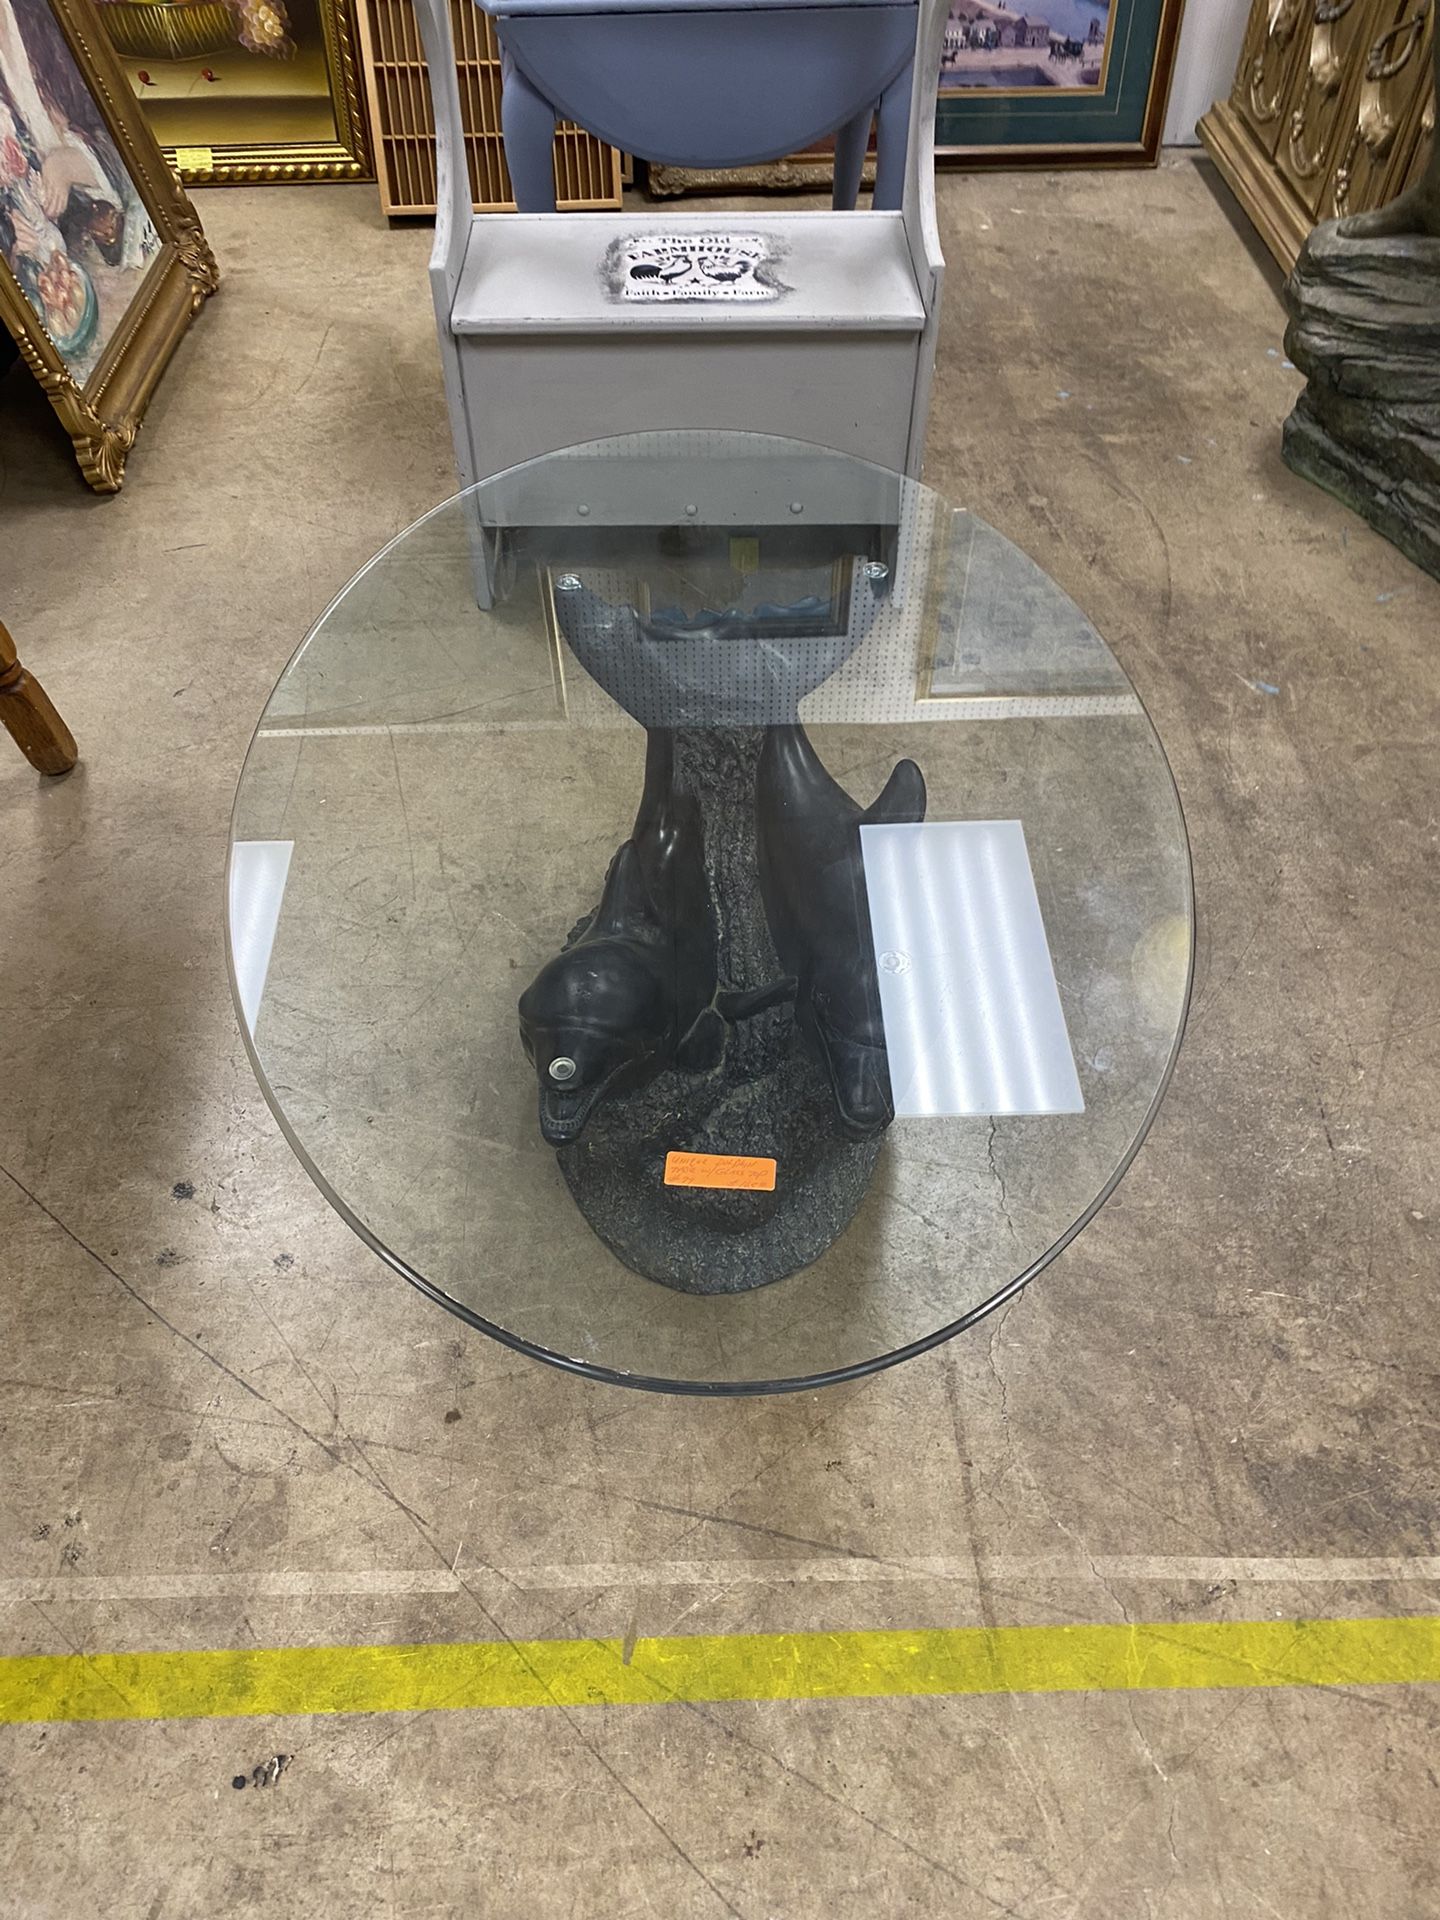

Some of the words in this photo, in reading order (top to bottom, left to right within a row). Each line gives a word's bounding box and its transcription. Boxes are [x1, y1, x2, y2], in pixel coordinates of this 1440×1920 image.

[658, 237, 692, 245] The
[699, 237, 730, 245] Old
[627, 246, 763, 260] FARMHOUSE
[672, 289, 719, 297] Family
